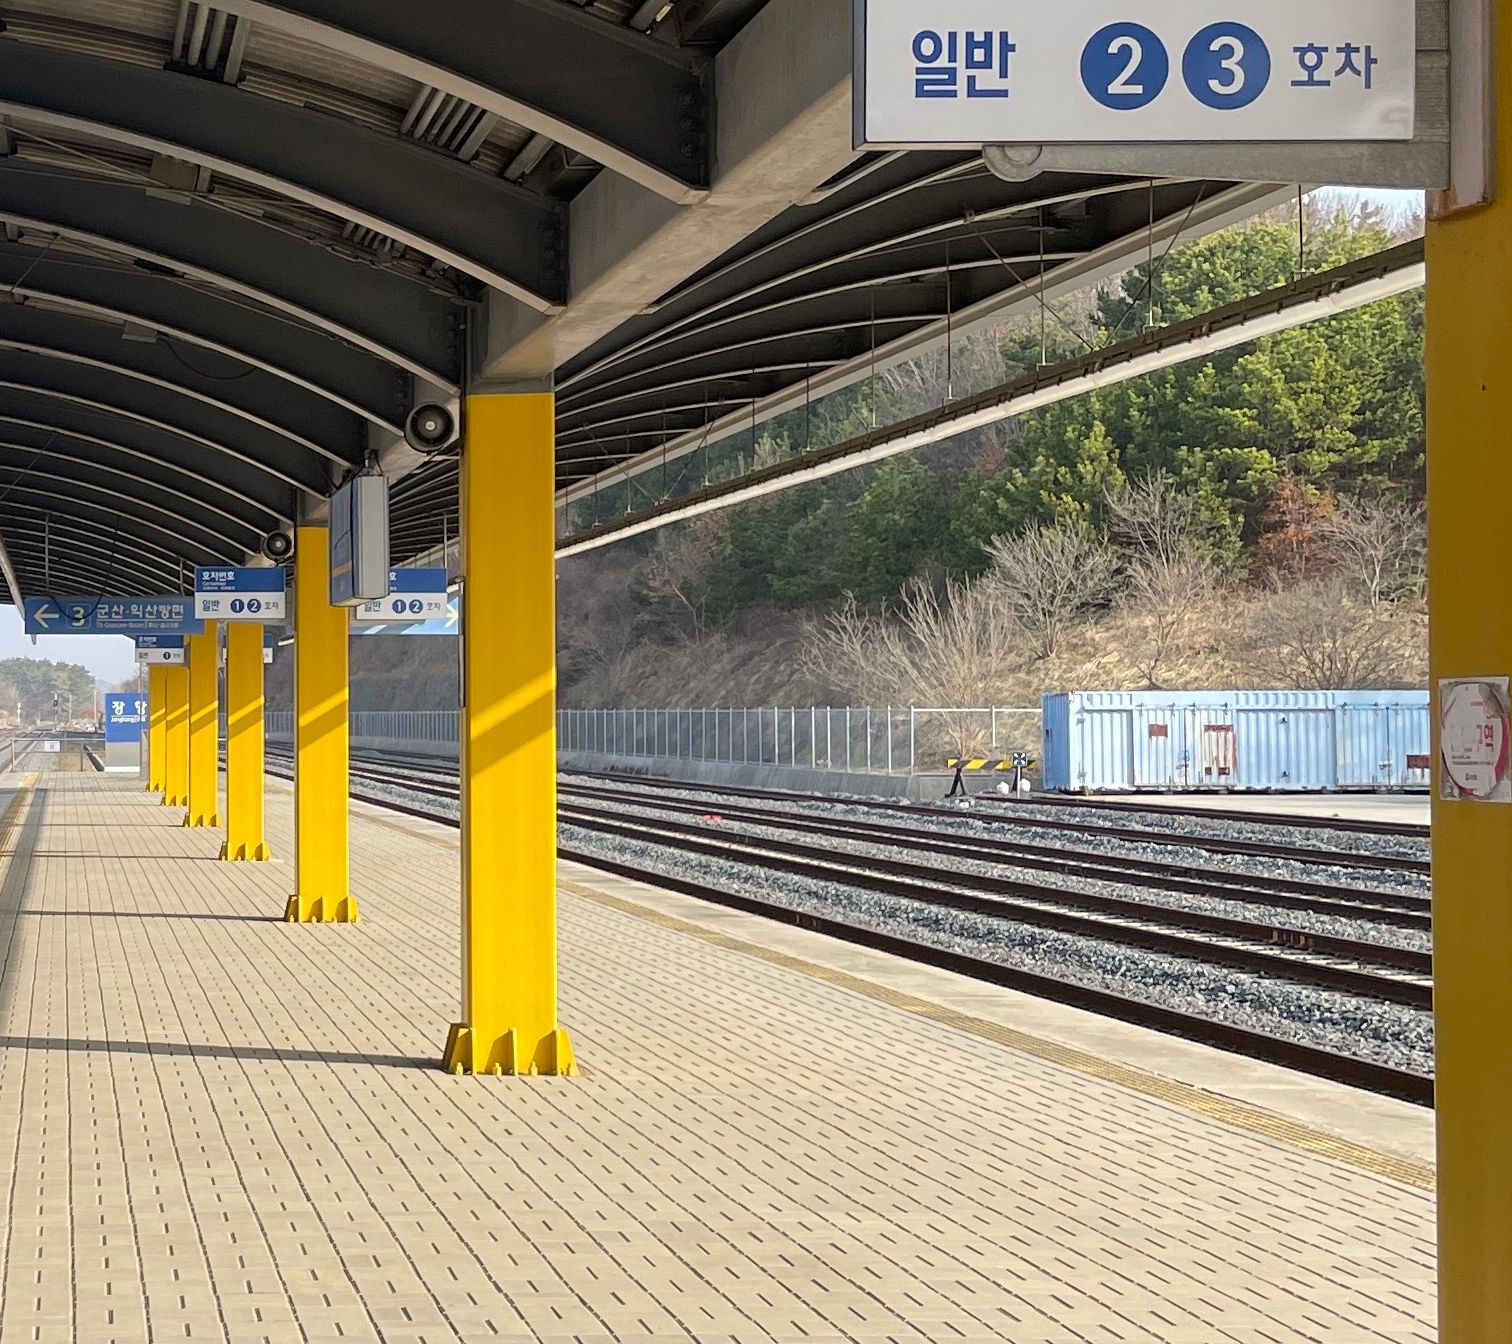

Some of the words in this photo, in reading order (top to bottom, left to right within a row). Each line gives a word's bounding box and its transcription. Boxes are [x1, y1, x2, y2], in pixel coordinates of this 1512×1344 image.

[912, 29, 1017, 99] 일반
[1107, 35, 1144, 95] 2
[1207, 35, 1245, 95] 3
[1290, 42, 1378, 90] 호차
[250, 600, 258, 612] 2
[412, 601, 420, 612] 2
[71, 606, 85, 627] 3
